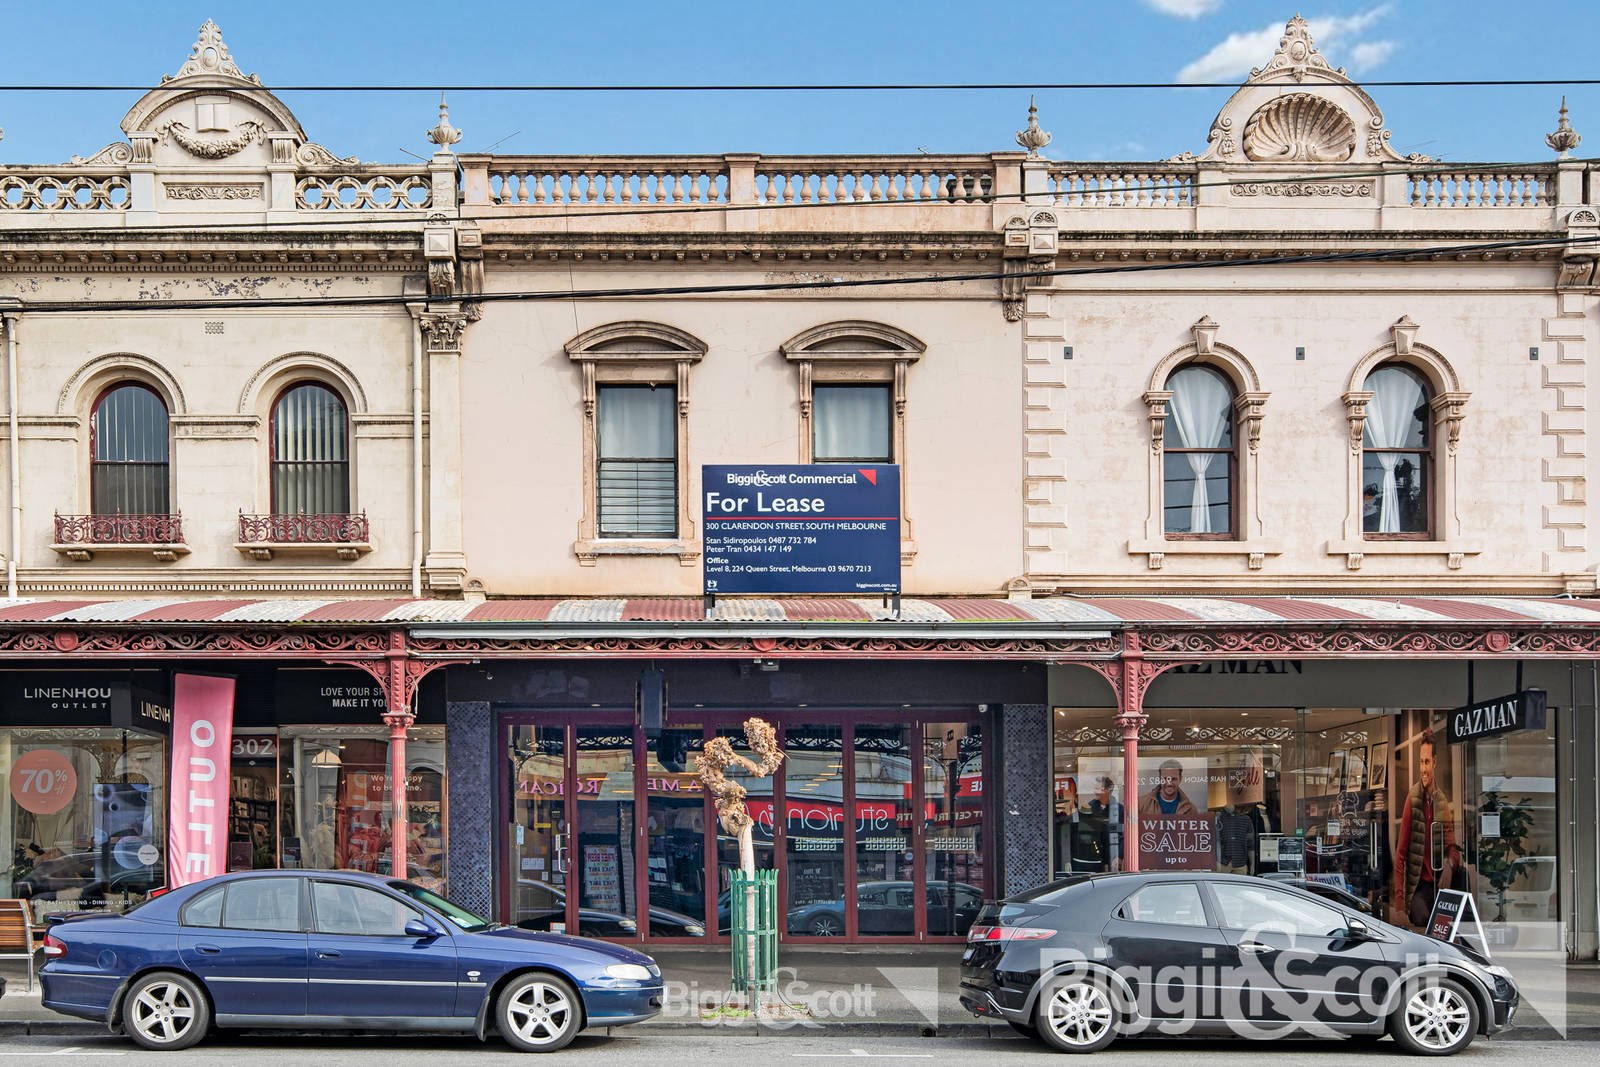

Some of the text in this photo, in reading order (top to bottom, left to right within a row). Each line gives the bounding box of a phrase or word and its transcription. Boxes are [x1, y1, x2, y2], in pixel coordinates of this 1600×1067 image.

[788, 473, 857, 484] Commercial
[706, 492, 825, 513] For Lease
[706, 522, 719, 530] 300
[721, 522, 774, 530] CLARENDON
[805, 522, 835, 530] SOUTH
[836, 522, 887, 530] MELBOURNE
[706, 536, 817, 546] Stan Sidiropoulos 0487 732 784
[706, 545, 792, 553] Peter Tran 0434 147 149
[706, 565, 723, 573] Level
[732, 565, 744, 573] 224
[745, 565, 768, 573] Queen
[791, 565, 827, 573] Melbourne
[827, 565, 836, 573] 03
[837, 565, 855, 573] 9670
[855, 565, 872, 573] 7213
[320, 687, 343, 696] LOVE
[345, 687, 370, 696] YOUR
[332, 698, 358, 708] MAKE
[360, 698, 369, 708] IT
[1454, 699, 1519, 737] GAZMAN
[232, 738, 273, 755] 302
[1142, 820, 1209, 831] WINTER
[1140, 832, 1212, 853] SALE
[1165, 857, 1177, 865] up
[1433, 923, 1449, 935] SALE
